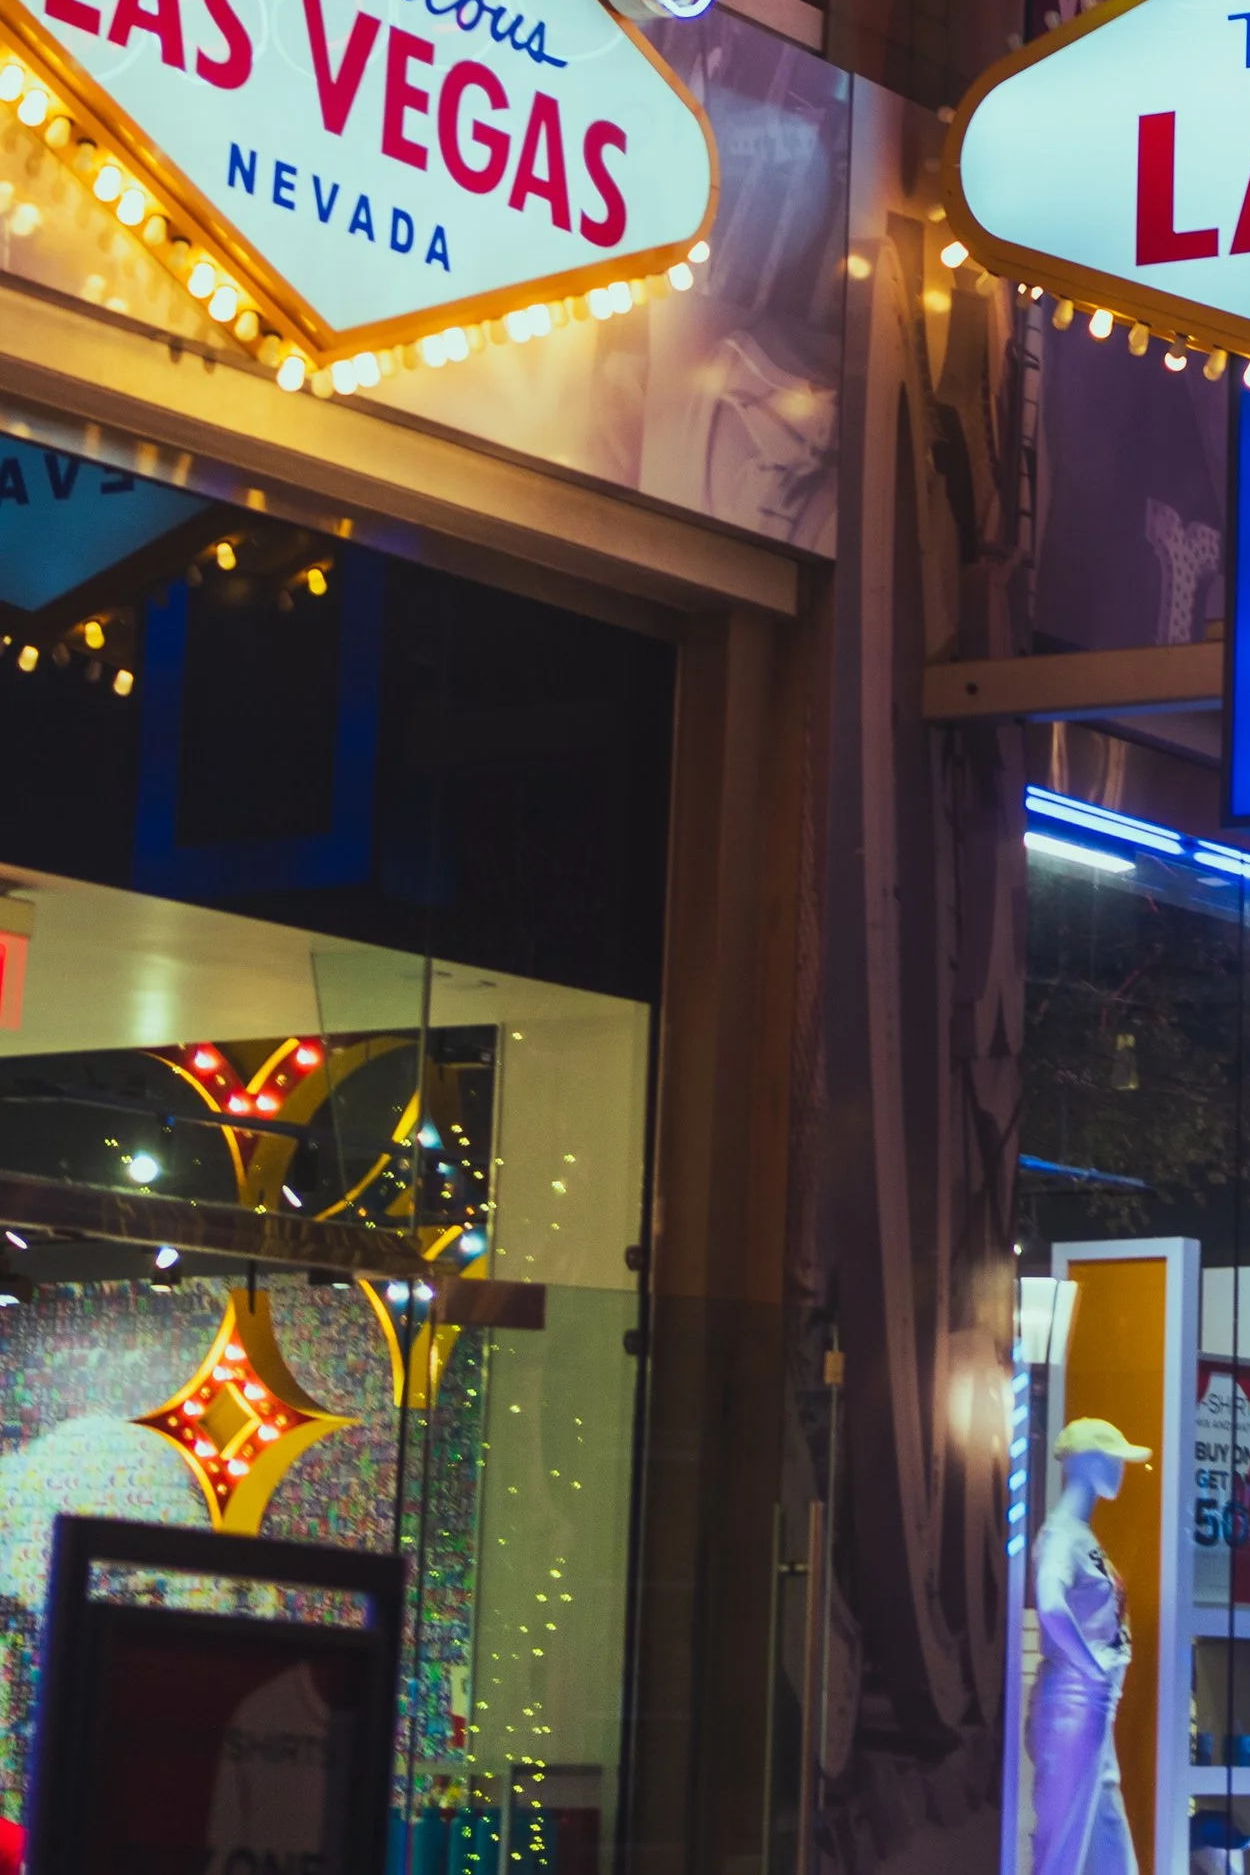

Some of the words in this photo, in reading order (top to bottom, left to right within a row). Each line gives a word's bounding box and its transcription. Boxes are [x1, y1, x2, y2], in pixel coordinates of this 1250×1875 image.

[229, 142, 452, 273] NEVADA
[1195, 1441, 1230, 1463] BUY
[1194, 1468, 1228, 1491] GET
